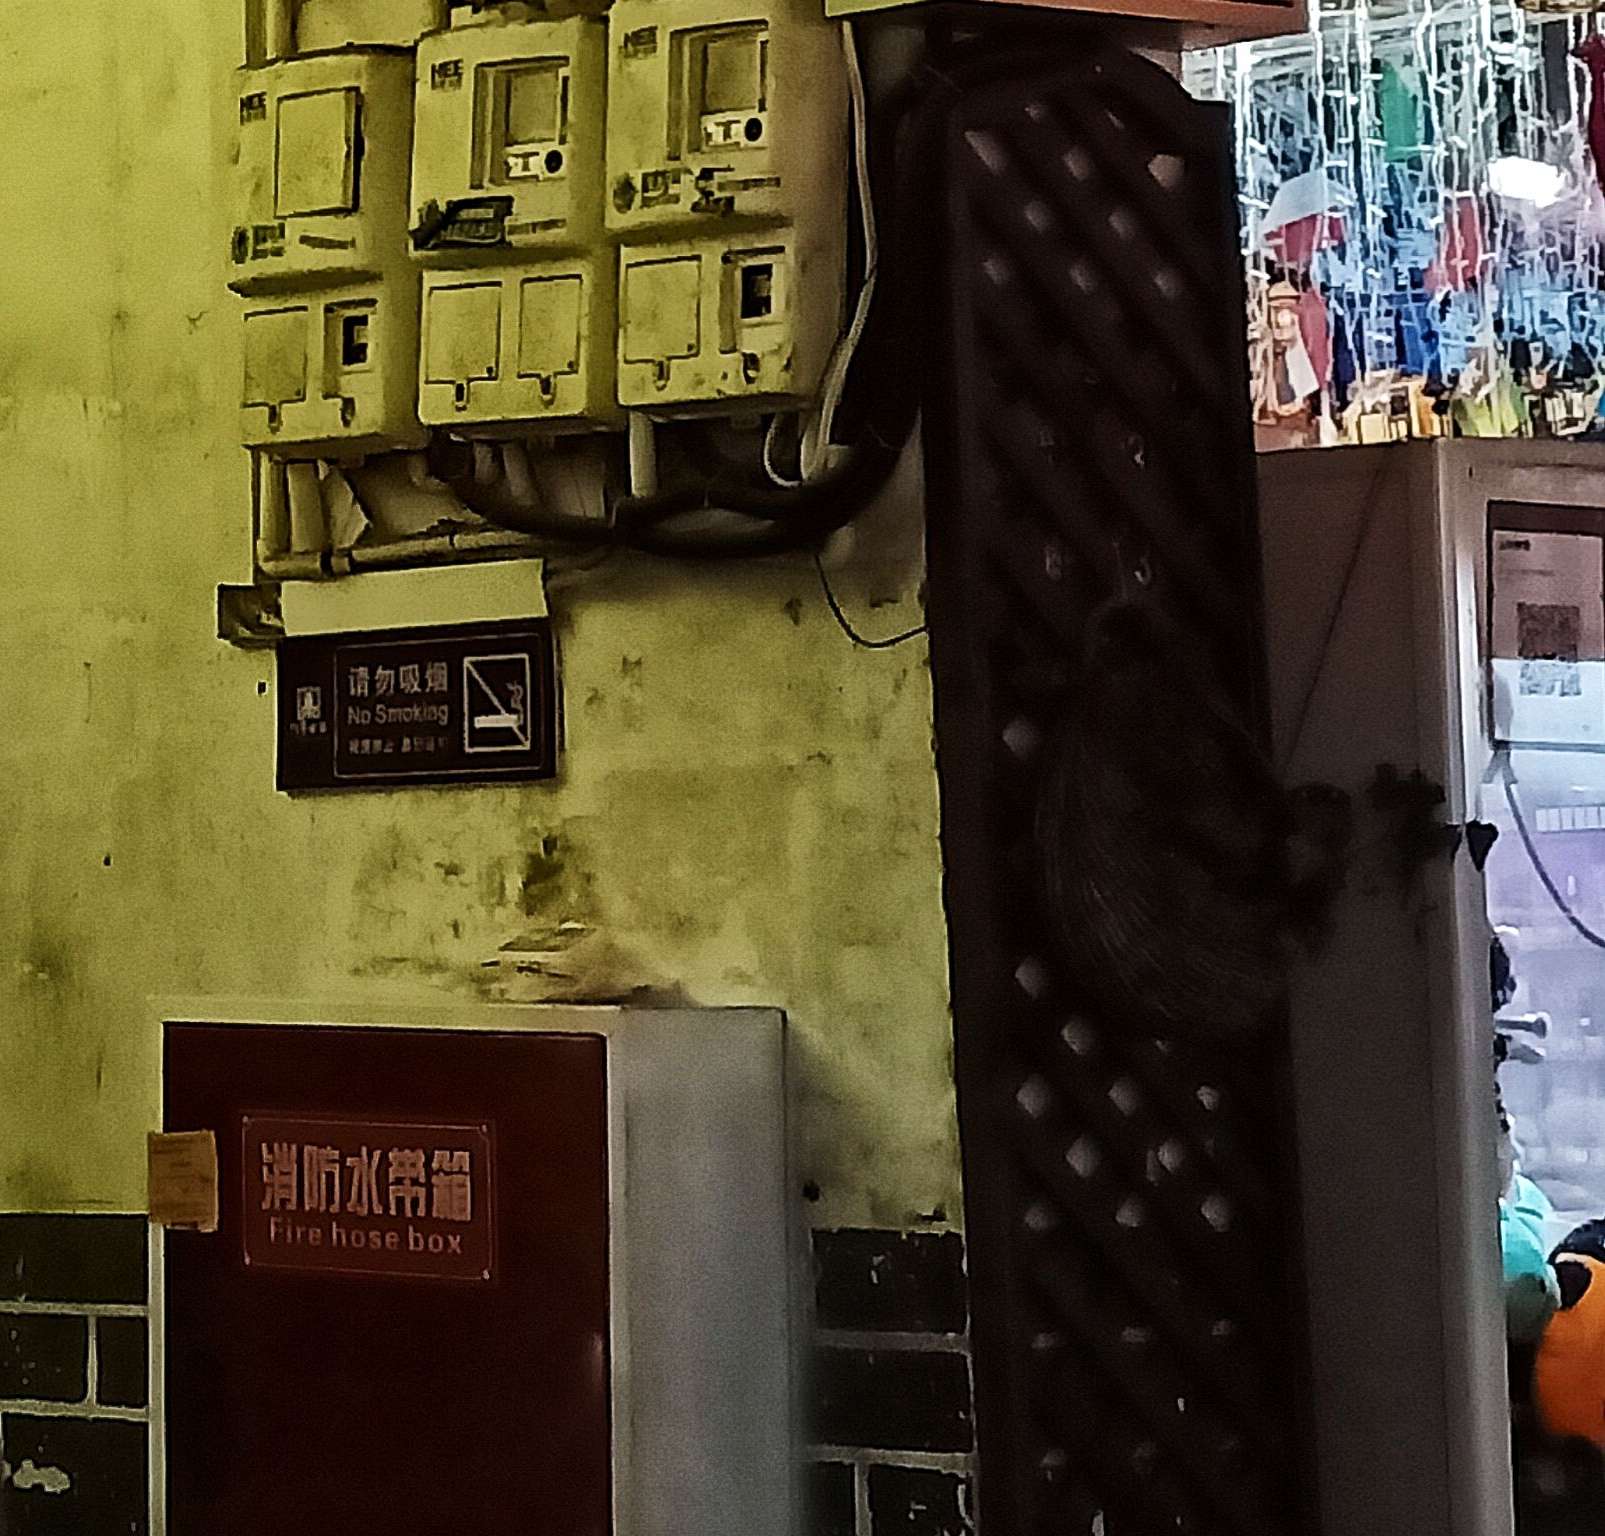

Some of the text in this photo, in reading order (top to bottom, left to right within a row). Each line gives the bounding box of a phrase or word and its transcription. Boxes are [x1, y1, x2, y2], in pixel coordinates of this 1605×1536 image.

[348, 662, 448, 698] 请勿吸烟
[348, 703, 449, 727] No Smoking
[270, 1216, 462, 1255] Fire hose box
